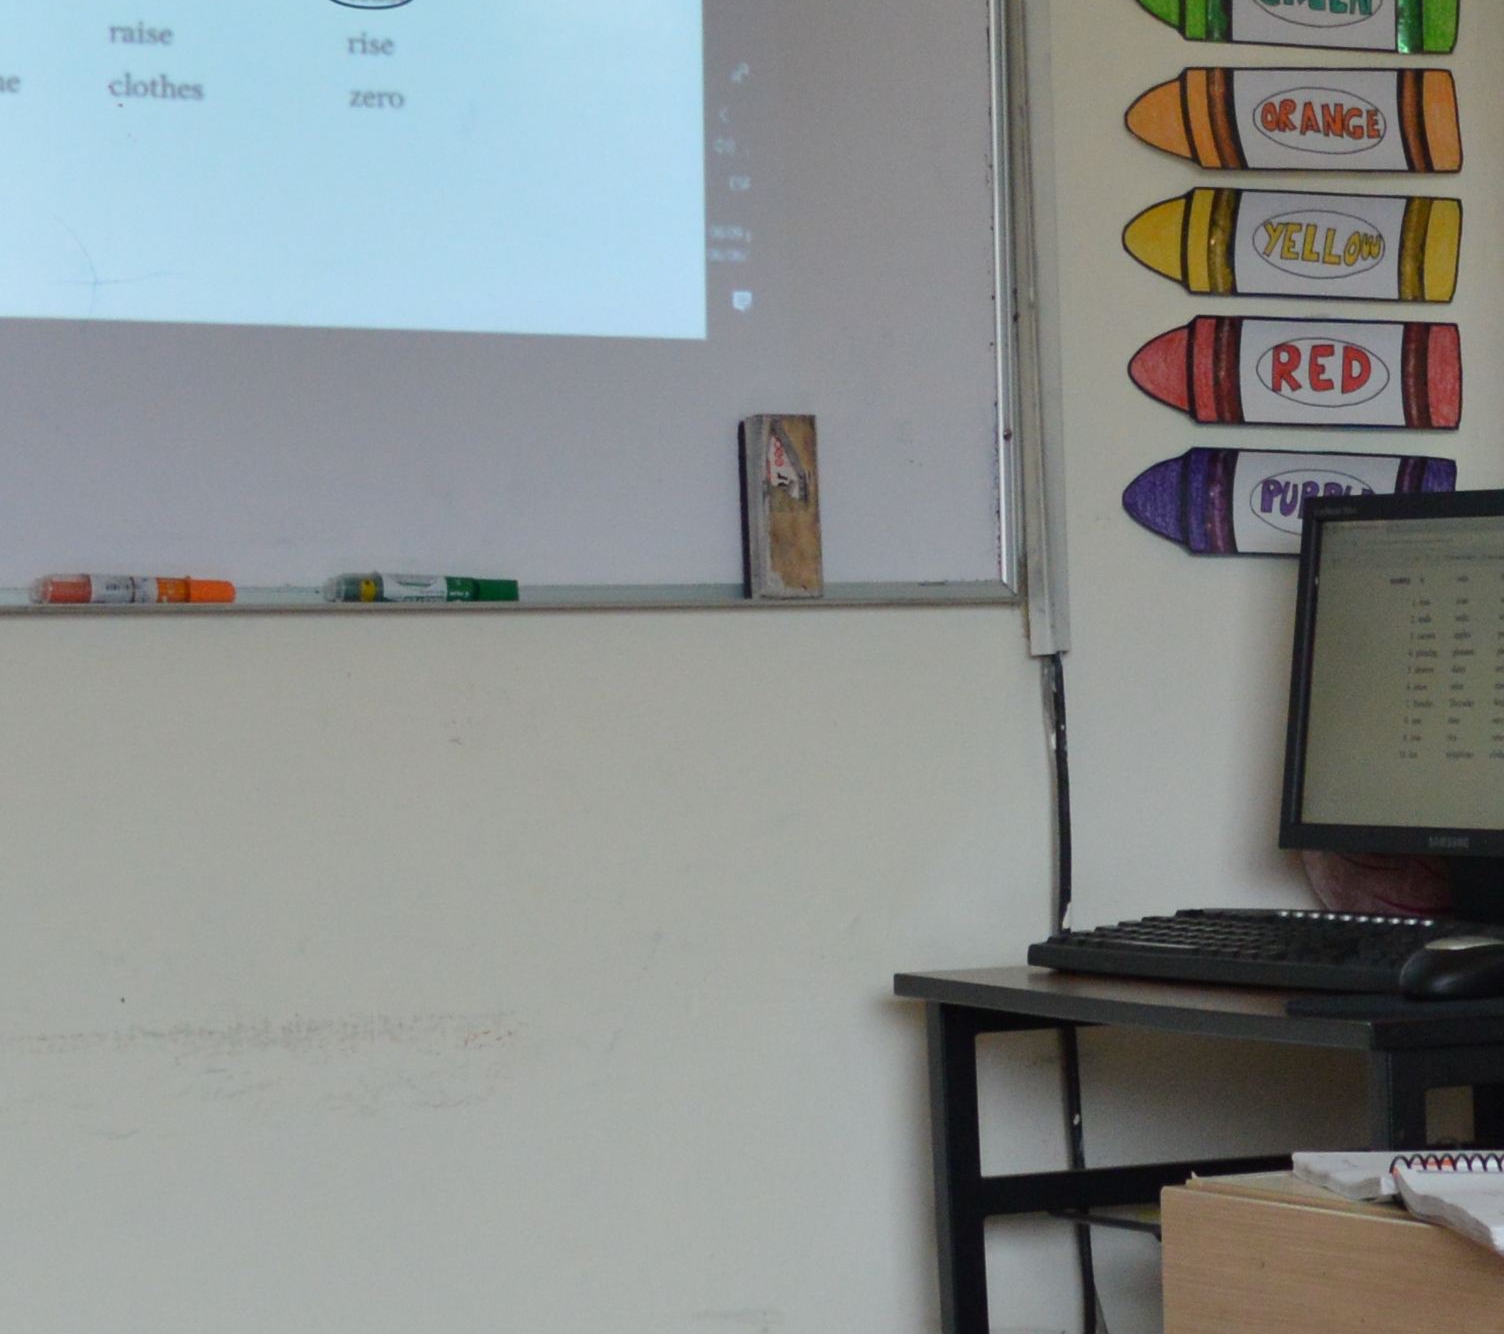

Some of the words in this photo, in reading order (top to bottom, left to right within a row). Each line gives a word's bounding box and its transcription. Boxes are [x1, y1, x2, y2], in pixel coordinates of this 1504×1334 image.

[108, 21, 175, 47] raise
[348, 32, 396, 57] rise
[109, 73, 205, 102] clothes
[349, 86, 406, 111] zero
[1260, 98, 1382, 140] ORANGE
[1263, 220, 1383, 267] YELLOW
[1270, 343, 1373, 395] RED
